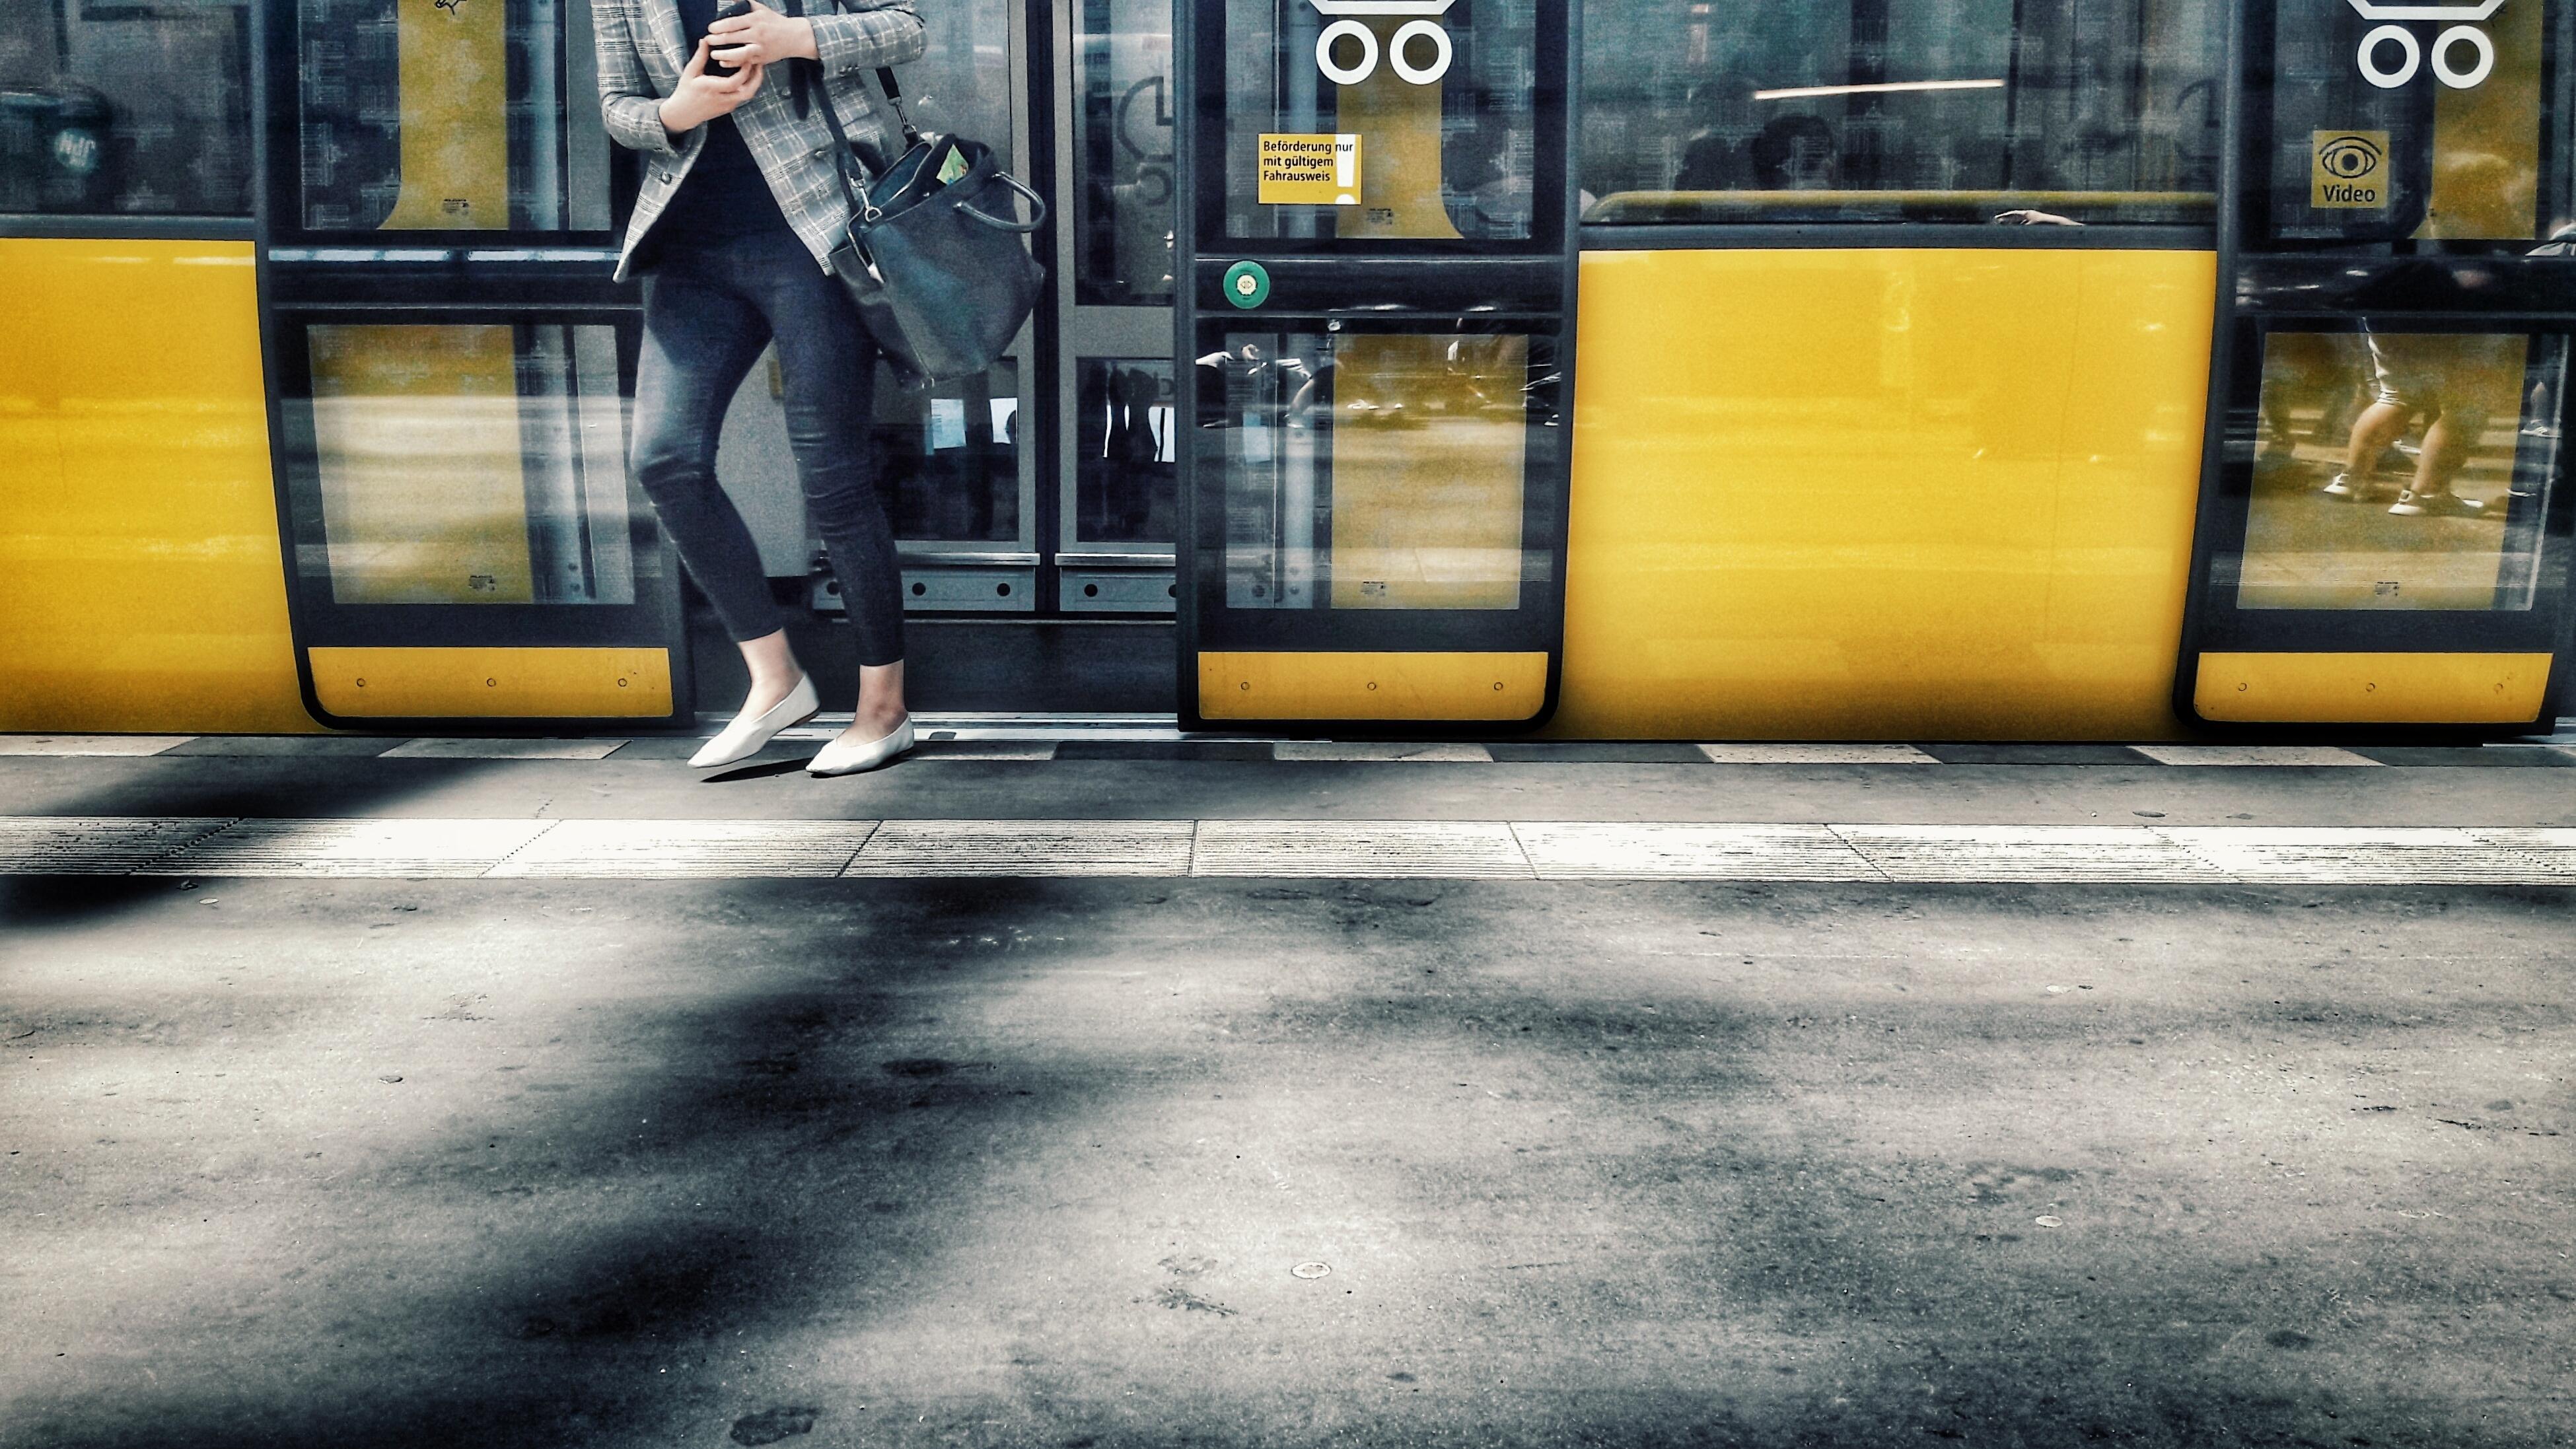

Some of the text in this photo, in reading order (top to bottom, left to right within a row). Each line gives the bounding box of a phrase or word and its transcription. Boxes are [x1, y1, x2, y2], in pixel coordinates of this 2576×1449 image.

[1264, 141, 1353, 154] Beförderung nur
[1264, 156, 1334, 169] mit gültigem
[1264, 170, 1330, 181] Fahrausweis
[2323, 184, 2376, 201] Video
